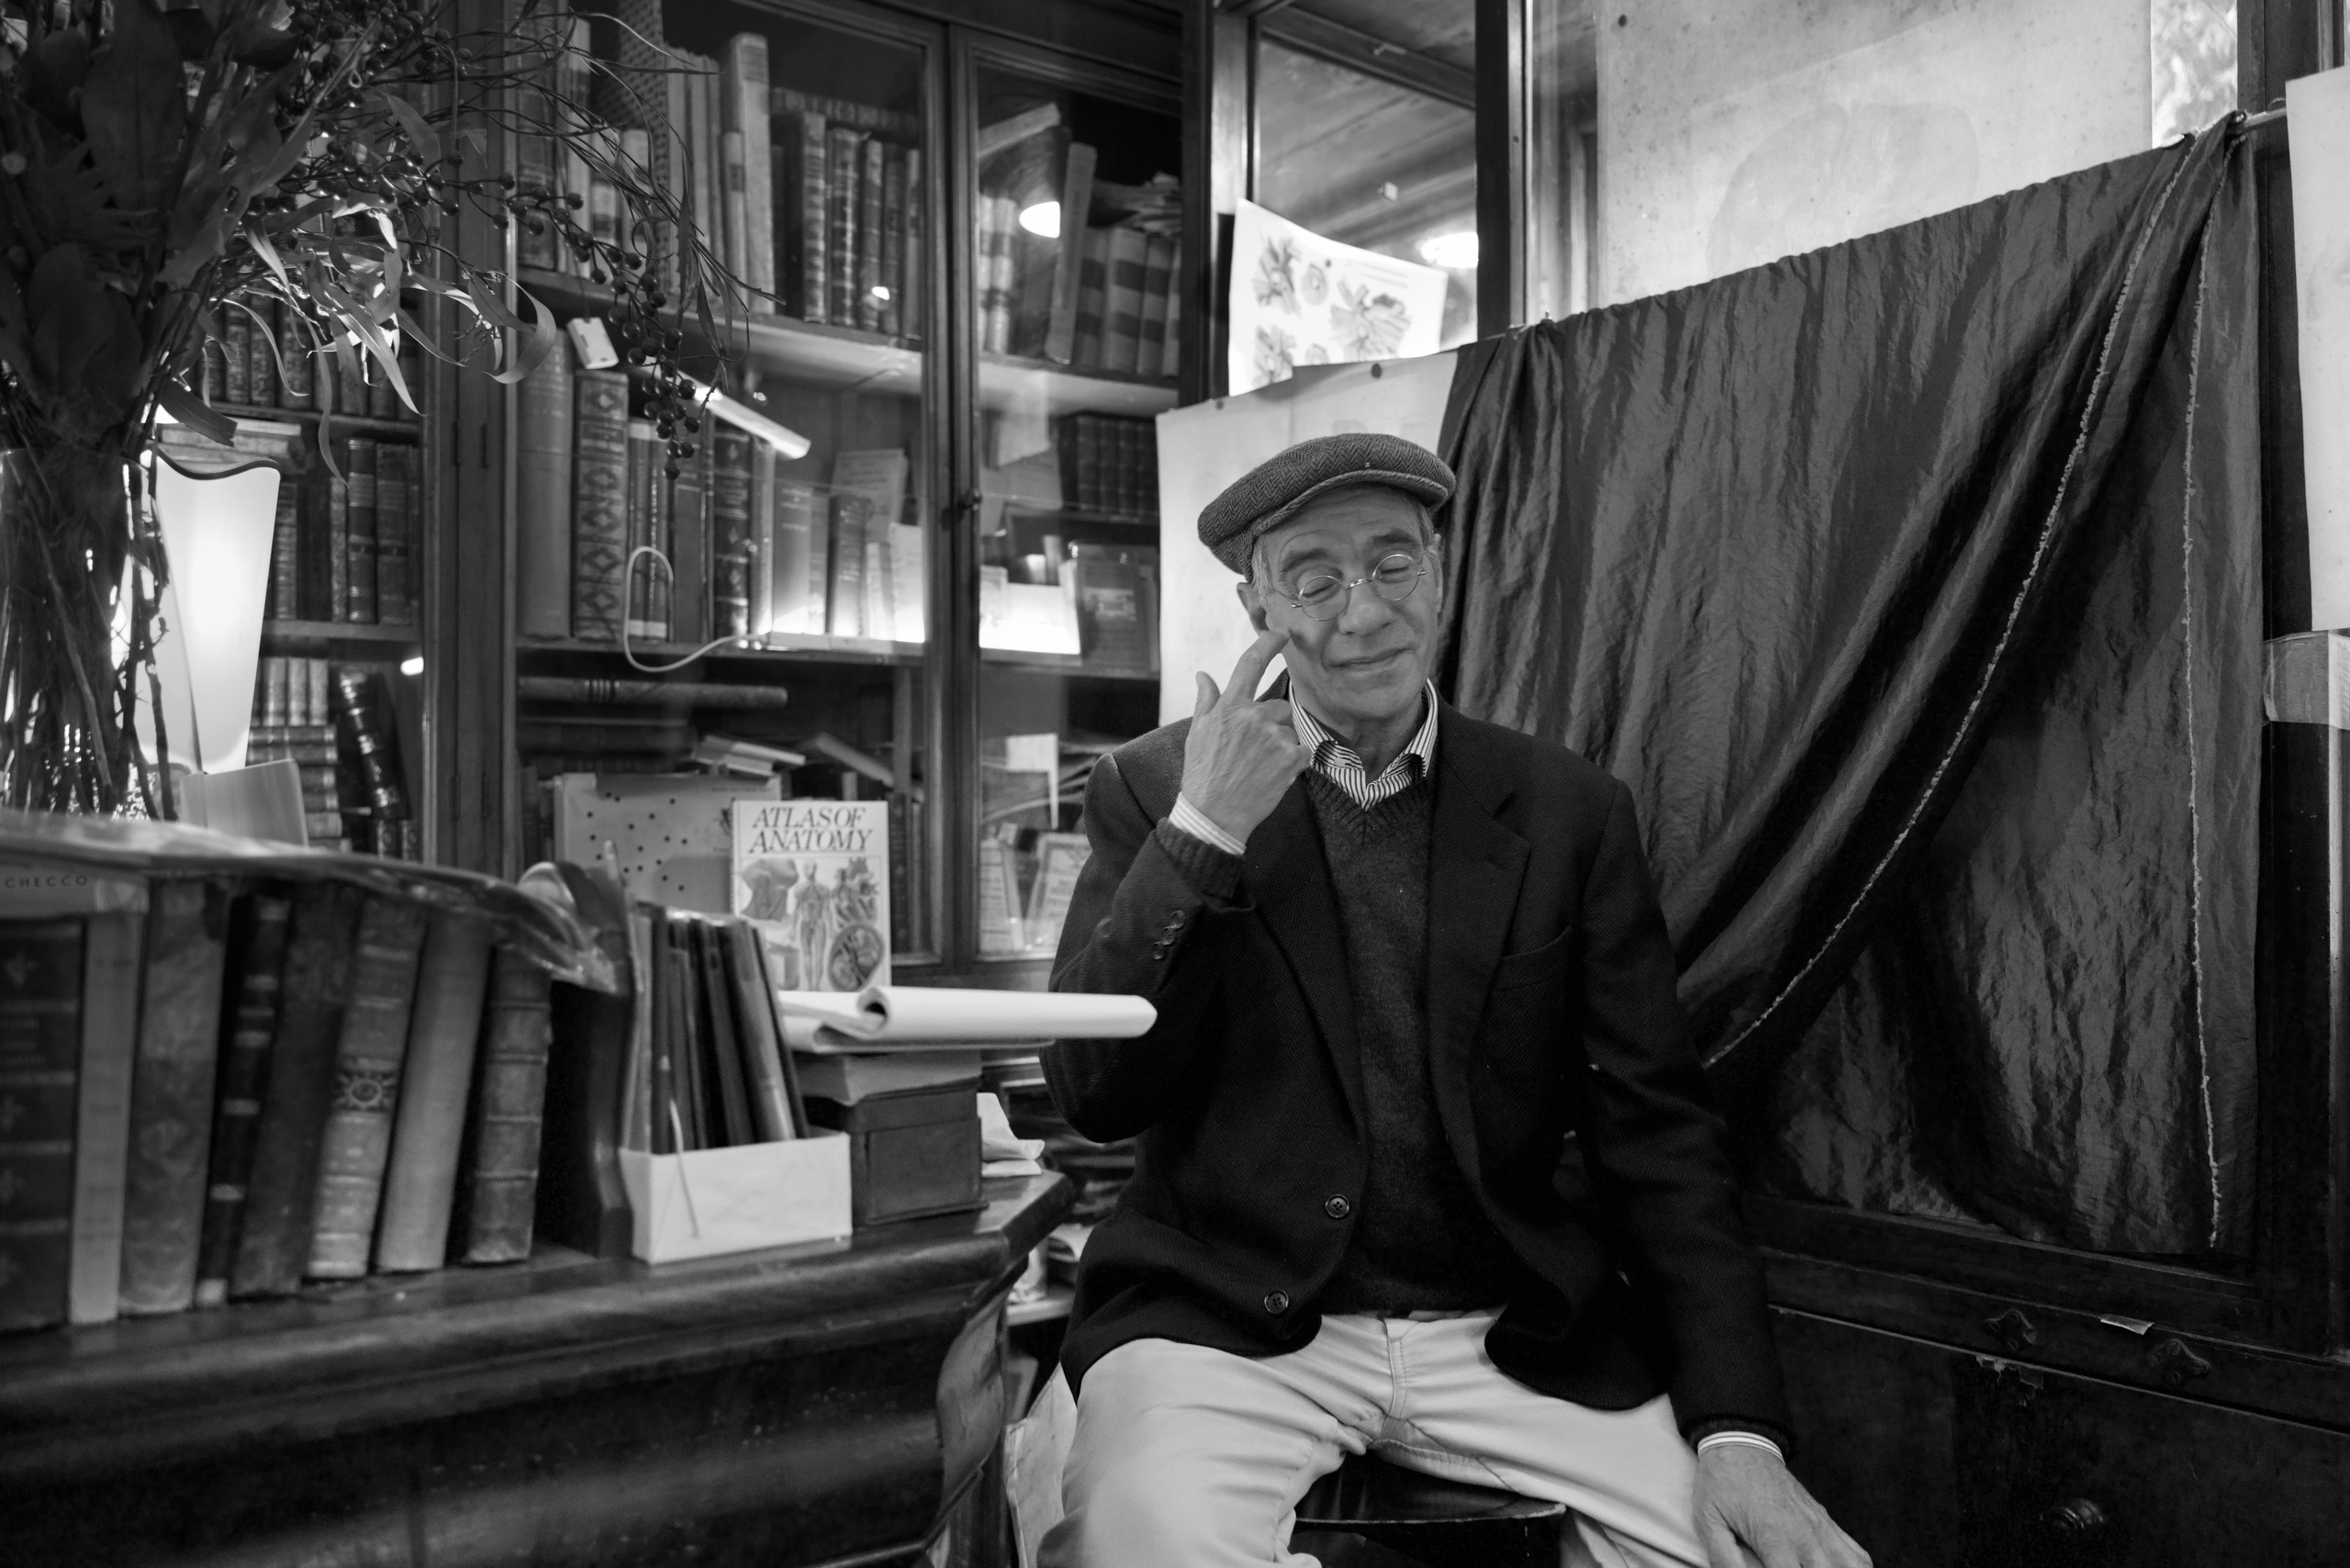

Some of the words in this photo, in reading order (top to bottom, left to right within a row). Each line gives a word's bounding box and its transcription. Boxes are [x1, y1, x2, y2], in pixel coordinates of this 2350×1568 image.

[752, 807, 833, 828] ATLAS
[834, 807, 866, 828] OF
[748, 830, 872, 852] ANATOMY
[5, 875, 88, 889] CHECCO
